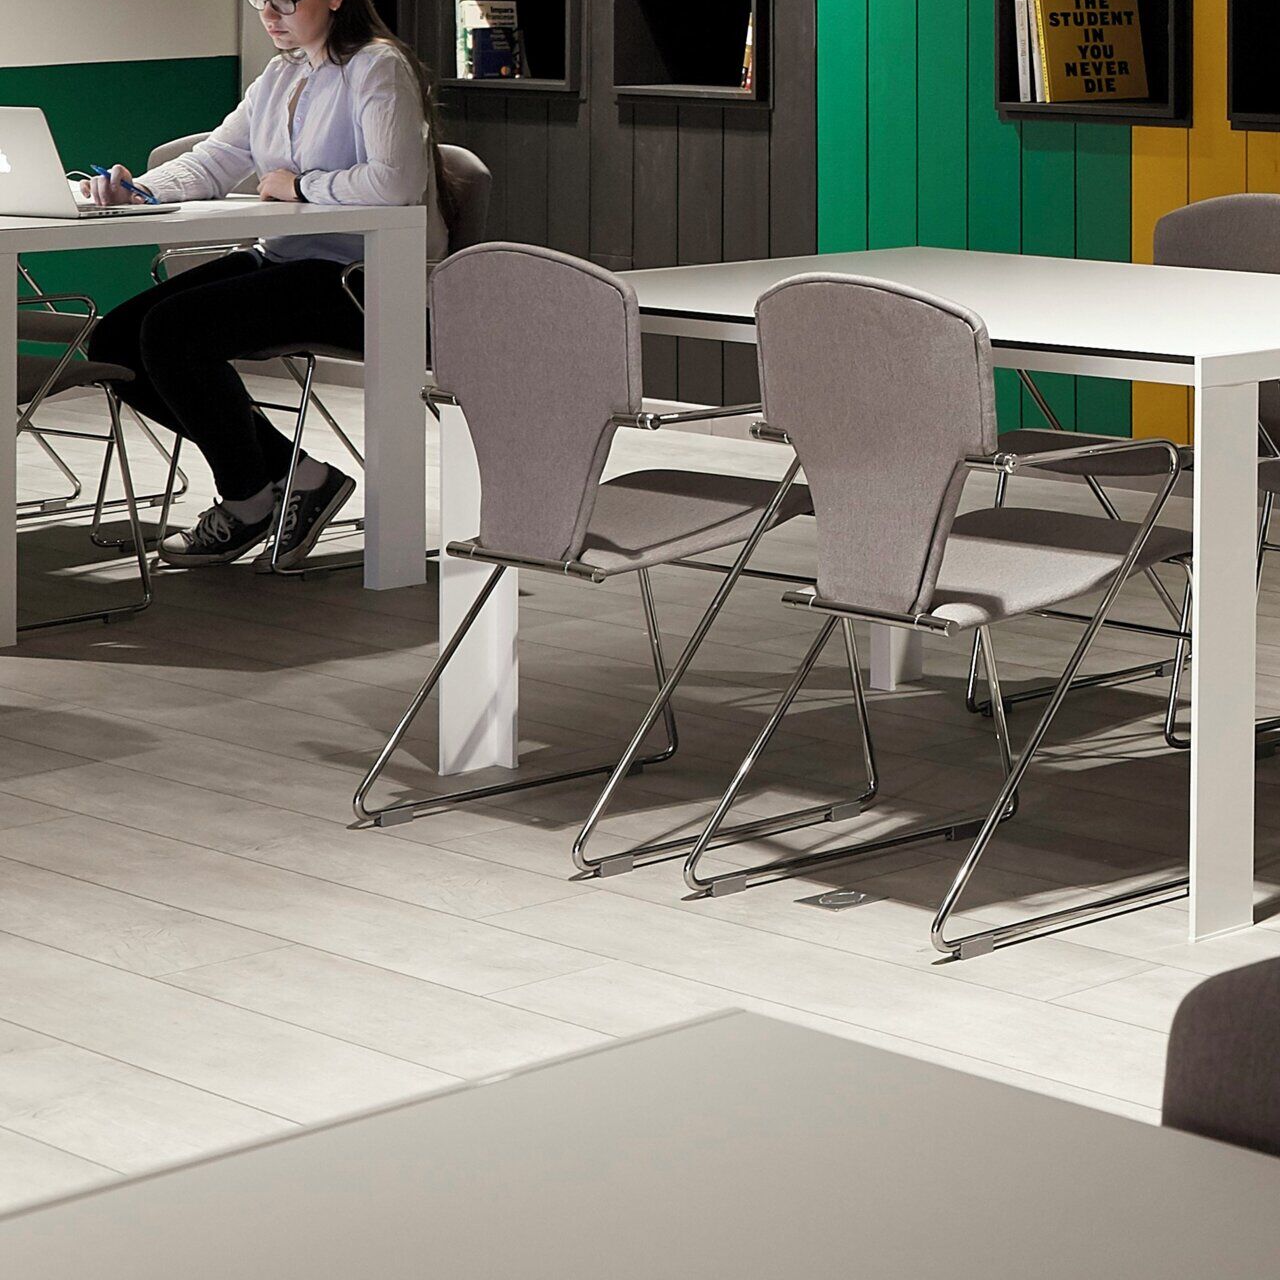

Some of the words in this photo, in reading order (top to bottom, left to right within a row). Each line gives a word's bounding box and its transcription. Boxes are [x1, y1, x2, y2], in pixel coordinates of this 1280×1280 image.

[1048, 11, 1134, 27] STUDENT
[1083, 28, 1104, 43] IN
[1077, 44, 1114, 60] YOU
[1065, 61, 1130, 77] NEVER
[1084, 78, 1116, 93] DIE
